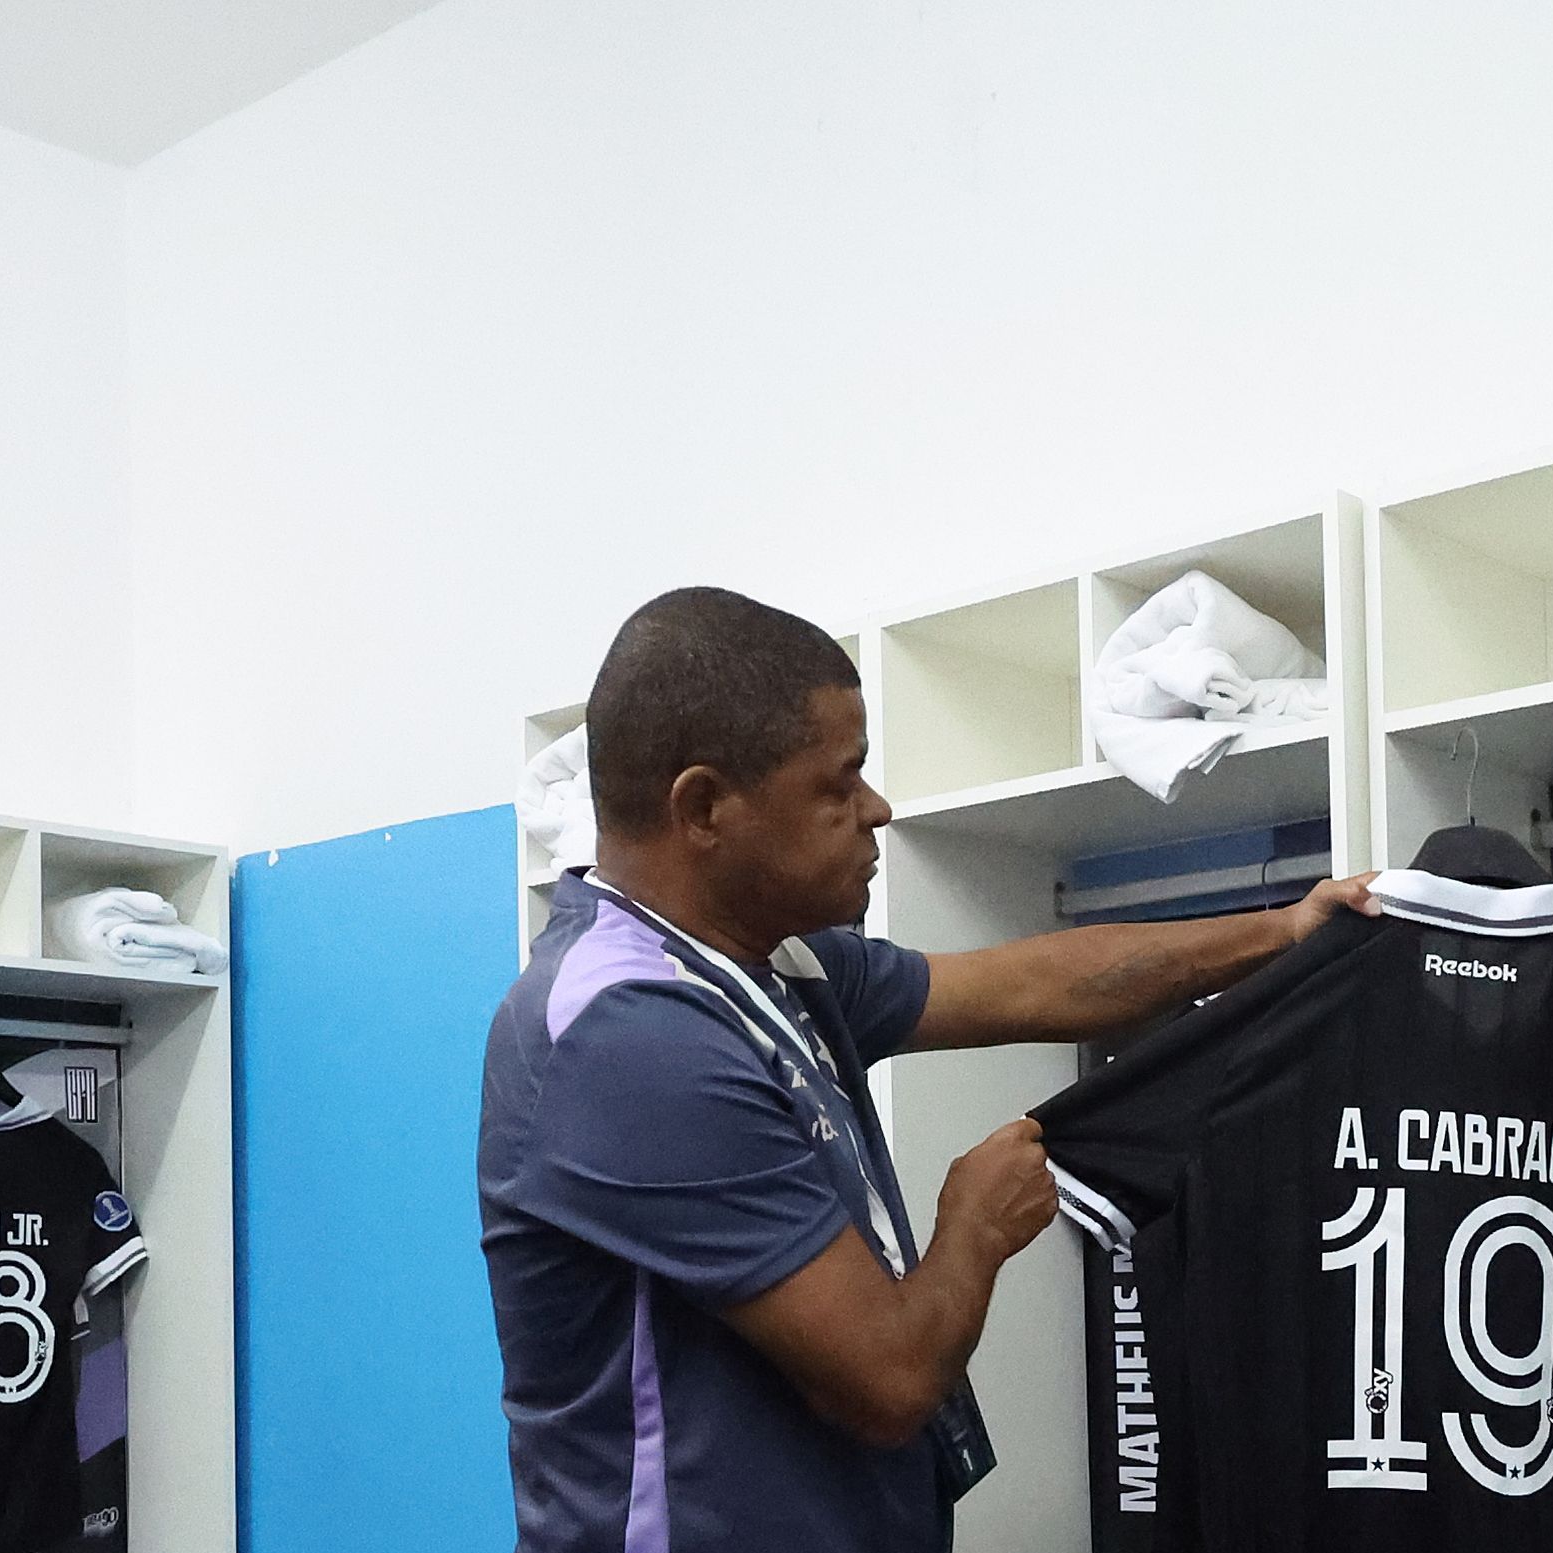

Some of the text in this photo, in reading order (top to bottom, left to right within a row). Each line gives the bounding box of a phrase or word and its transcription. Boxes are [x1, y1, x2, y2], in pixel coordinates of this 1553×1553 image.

[1424, 953, 1518, 983] Reebok
[1333, 1107, 1379, 1170] A.
[6, 1213, 49, 1246] JR.
